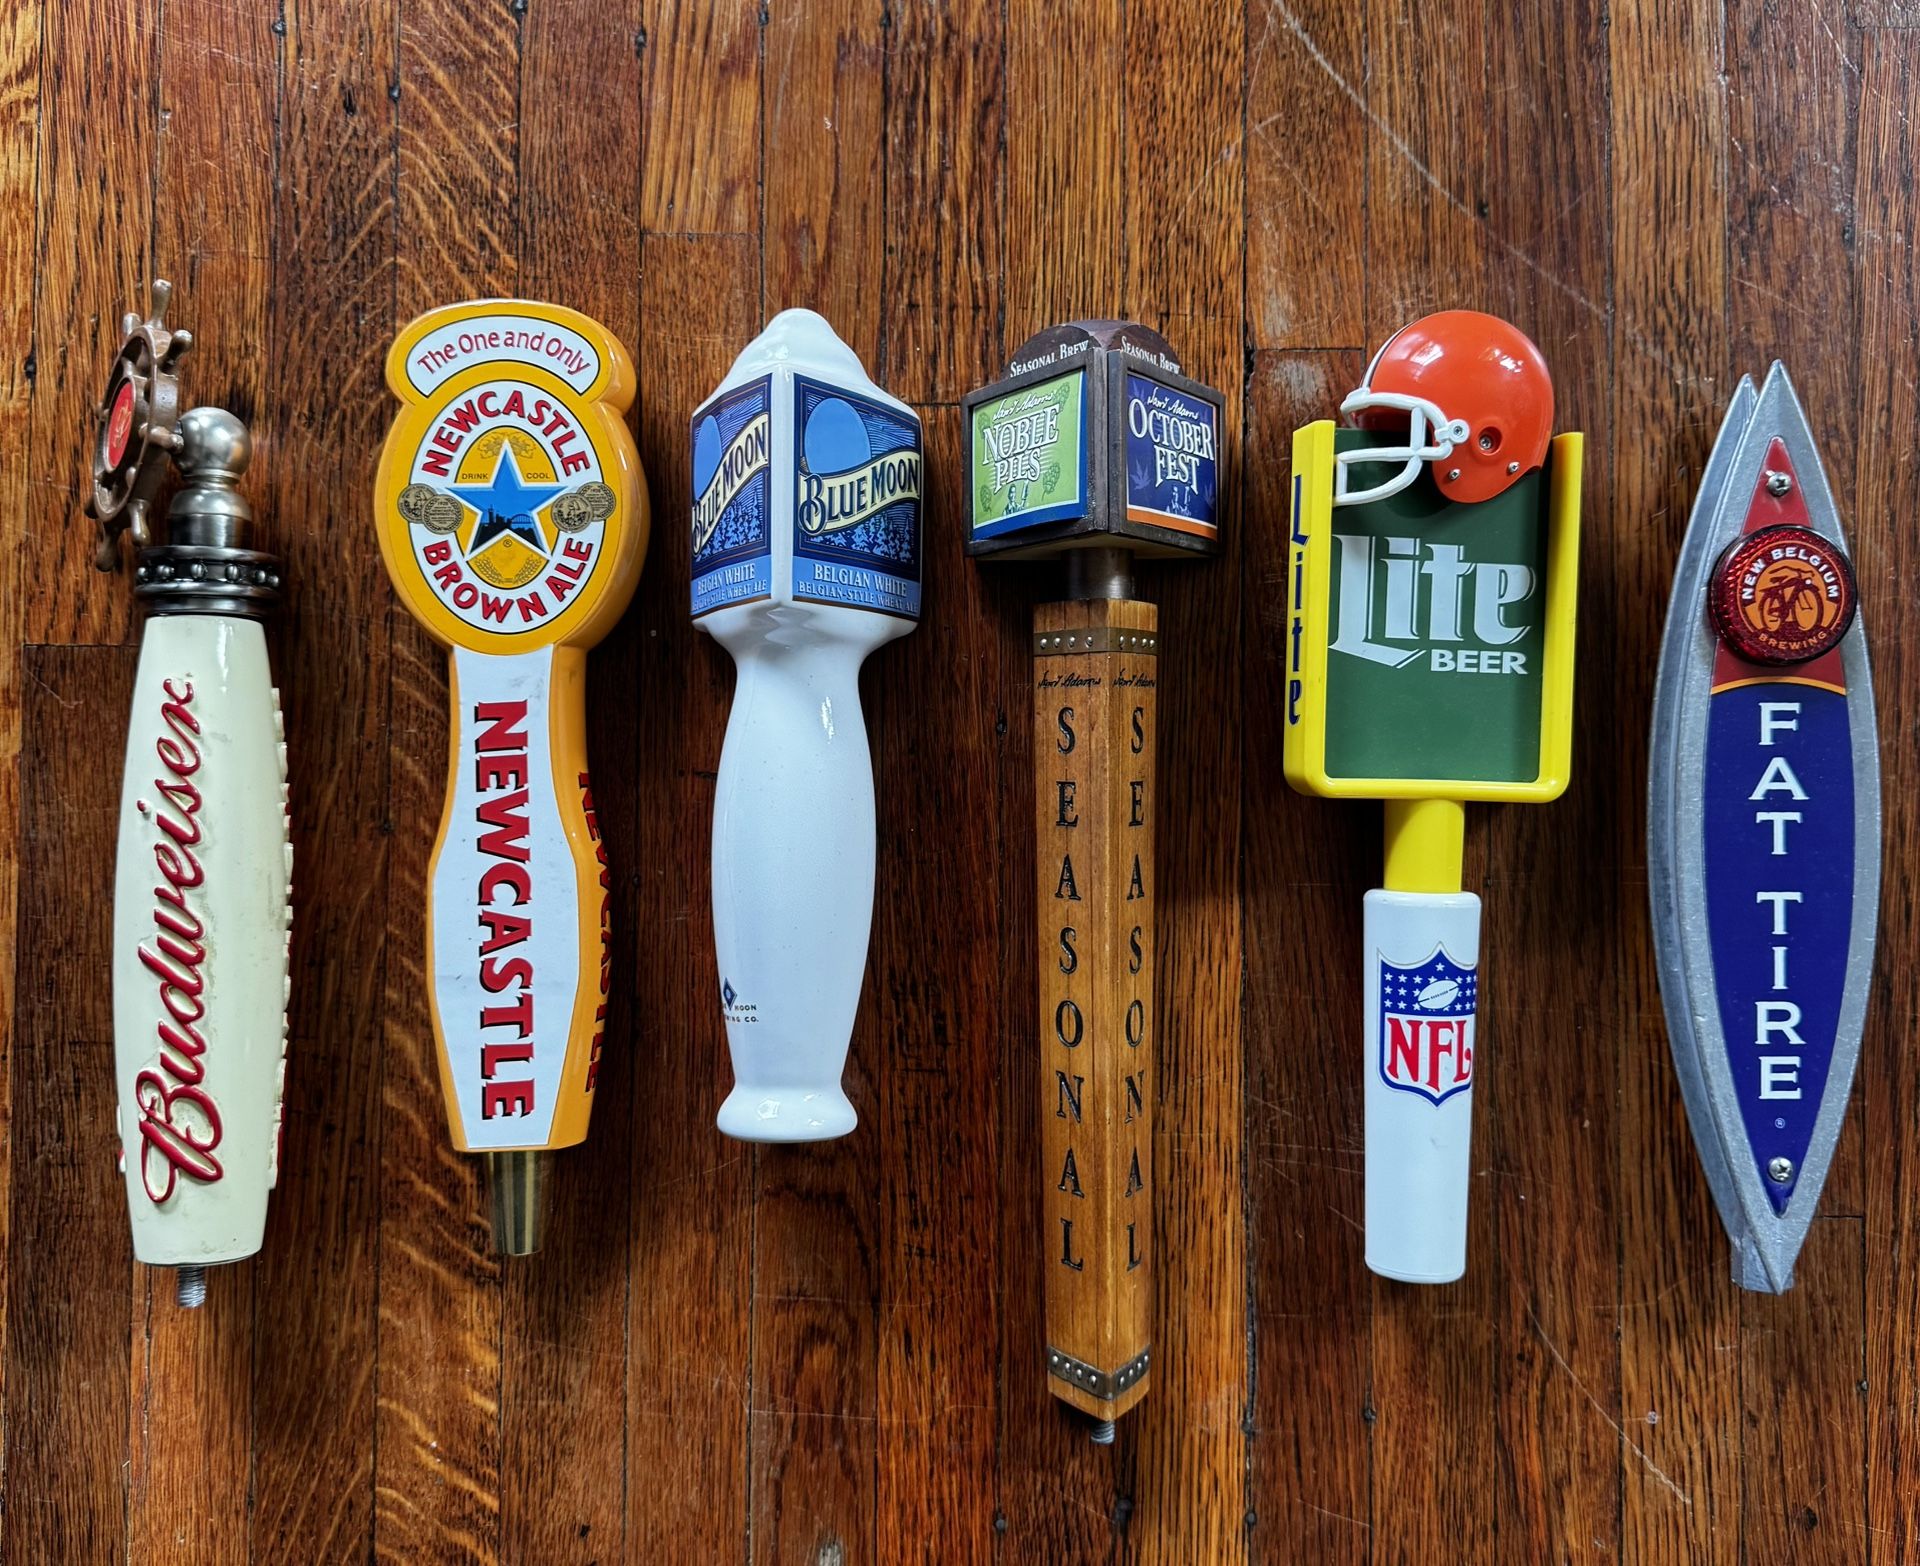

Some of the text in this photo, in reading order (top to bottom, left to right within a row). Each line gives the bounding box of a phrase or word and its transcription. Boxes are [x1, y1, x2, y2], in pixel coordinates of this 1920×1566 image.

[417, 330, 591, 376] The One and Only
[1010, 340, 1089, 378] SEASONAL BREW
[1121, 336, 1181, 375] SEASONAL BREW
[422, 390, 591, 477] NEWCASTLE
[983, 404, 1060, 467] NOBLE
[1128, 398, 1215, 461] OCTOBER
[461, 472, 551, 481] DRINK COOL
[692, 421, 768, 555] BLUE MOON
[799, 458, 920, 535] BLUE MOON
[993, 448, 1042, 495] PILS
[1153, 444, 1200, 495] FEST
[423, 537, 593, 623] BROWN ALE
[725, 563, 756, 586] WHITE
[752, 579, 767, 593] ALE
[798, 581, 874, 604] BELGIAN-STYLE
[877, 594, 903, 611] WHEAT
[813, 563, 908, 598] BELGIAN WHITE
[1288, 474, 1311, 726] Lite
[1328, 534, 1537, 669] Lite
[1741, 547, 1840, 600] NEW BELGIUM
[1430, 650, 1528, 675] BEER
[1758, 631, 1828, 650] BREWING
[474, 699, 535, 1120] NEWCASTLE
[1748, 702, 1810, 1100] FAT TIRE
[137, 677, 224, 1204] Budweiser
[1054, 706, 1085, 1272] SEASONAL
[1124, 706, 1145, 1272] SEASONAL
[1387, 1017, 1472, 1092] NFL
